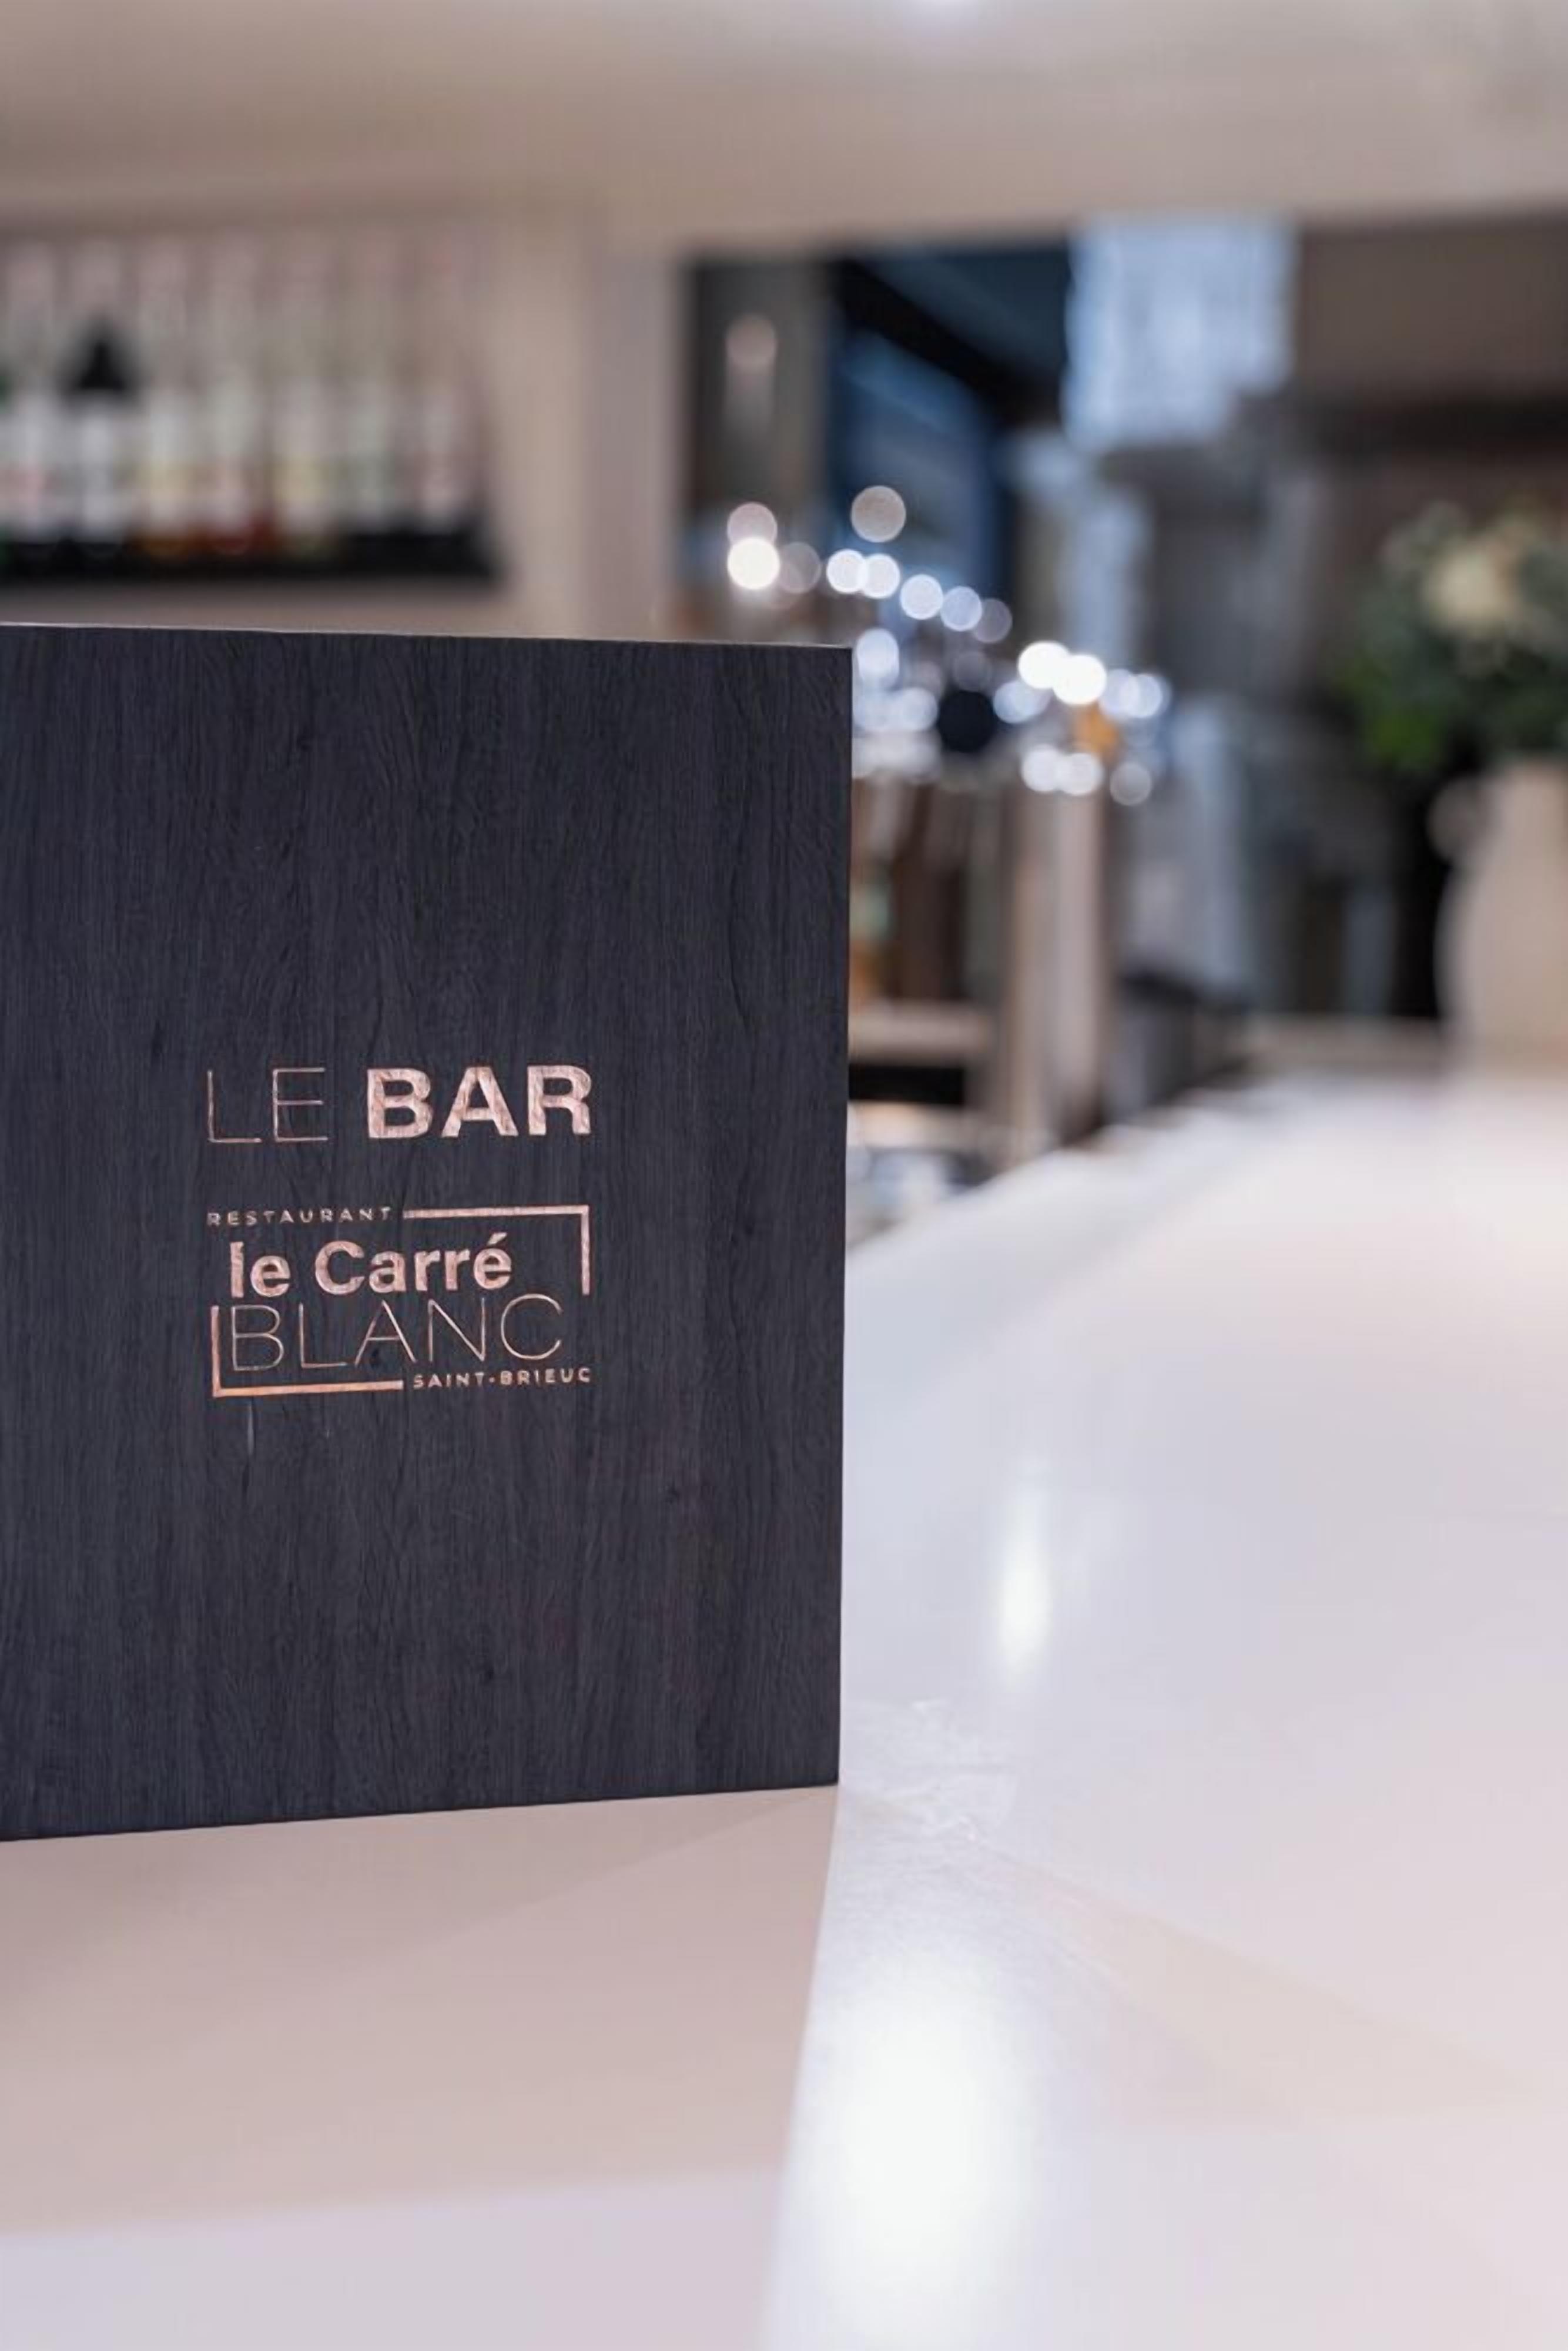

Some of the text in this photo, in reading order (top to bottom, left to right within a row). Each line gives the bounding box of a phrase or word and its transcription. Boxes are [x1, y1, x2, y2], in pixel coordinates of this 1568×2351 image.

[207, 1064, 592, 1143] LE BAR
[207, 1207, 392, 1227] RESTAURANT
[230, 1232, 512, 1298] le Carré
[230, 1292, 563, 1372] BLANC
